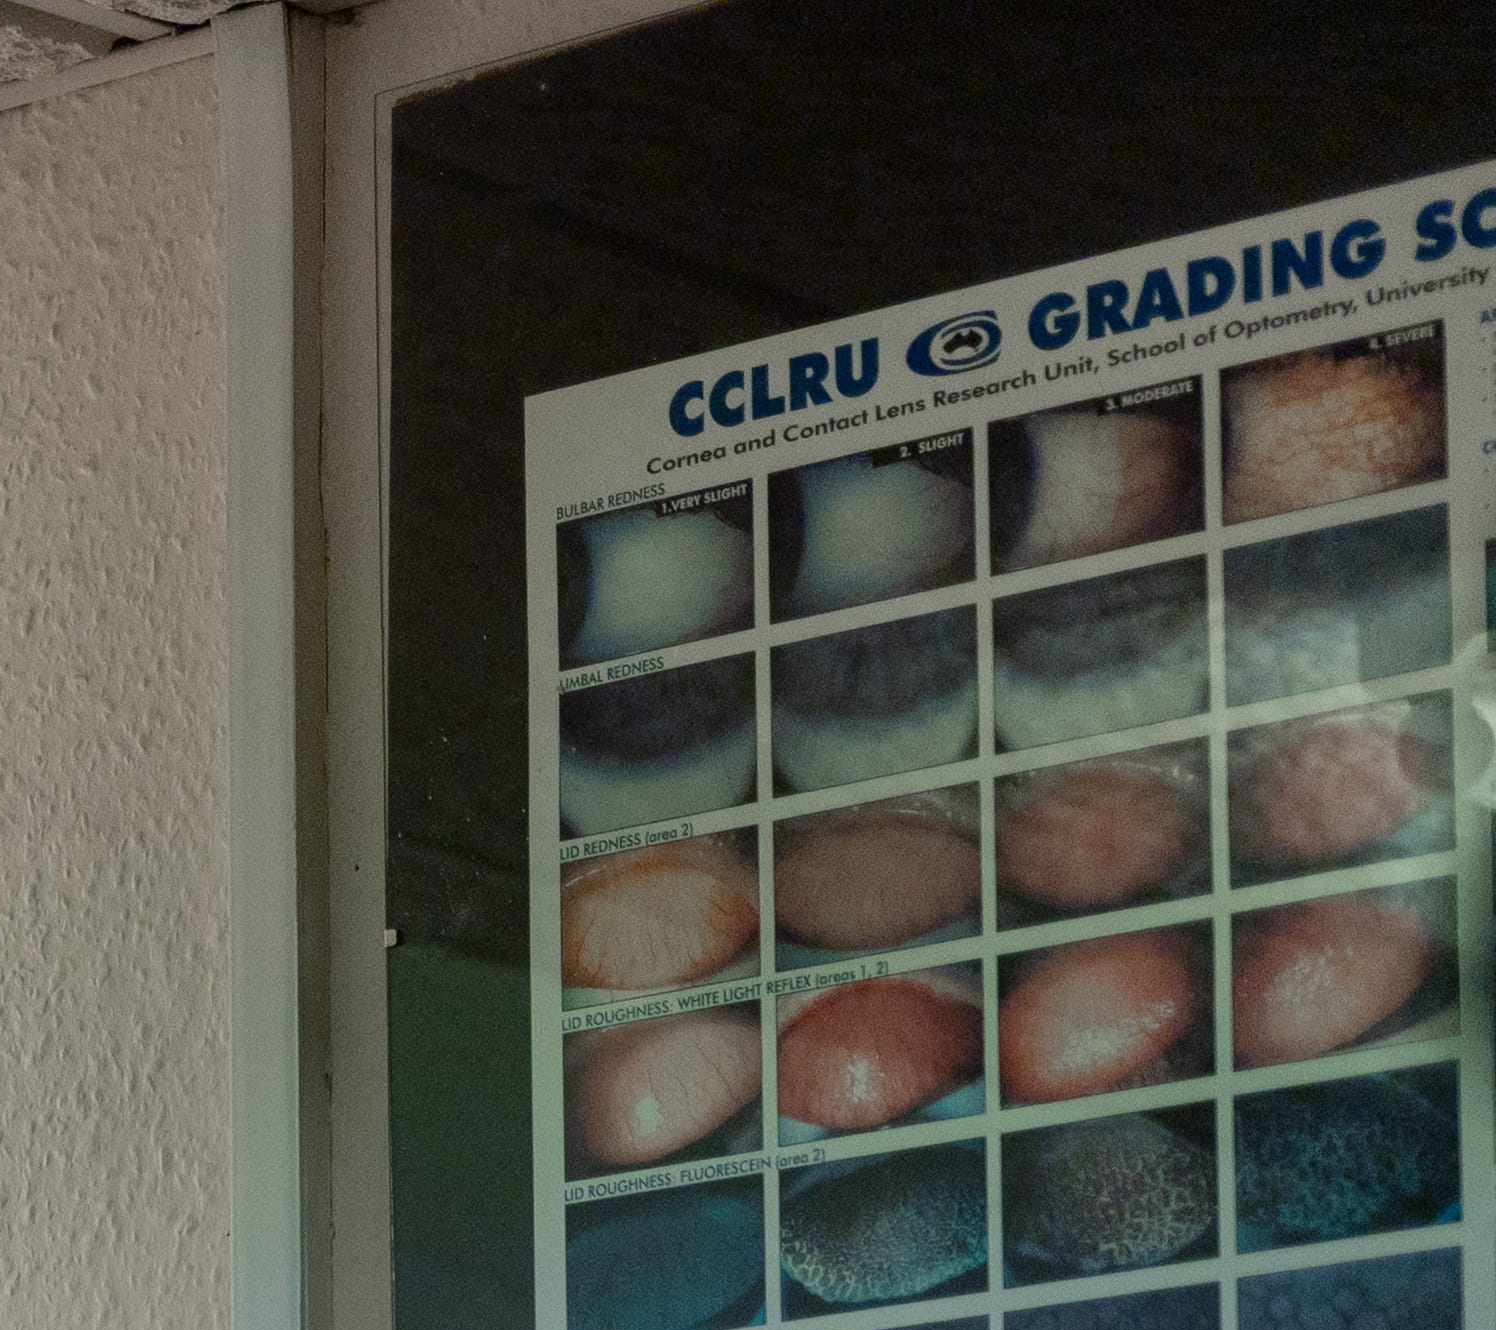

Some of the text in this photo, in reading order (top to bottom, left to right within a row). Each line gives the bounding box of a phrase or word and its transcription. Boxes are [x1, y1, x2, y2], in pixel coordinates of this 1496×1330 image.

[668, 338, 880, 437] CCLRU
[1028, 218, 1386, 351] GRADING
[646, 264, 1490, 476] Cornea and Contact Lens Research Unit, School of Optometry, University
[1121, 379, 1194, 409] MODERATE
[918, 433, 964, 456] SLIGHT
[556, 484, 665, 520] BULBAR REDNESS
[703, 484, 748, 508] SLIGHT
[608, 657, 664, 680] REDNESS
[560, 823, 693, 860] LID REDNESS (area 2)
[561, 973, 811, 1031] LID ROUGHNESS: WHITE LIGHT REFLEX
[564, 1156, 772, 1202] LID ROUGHNESS: FLUORESCEIN
